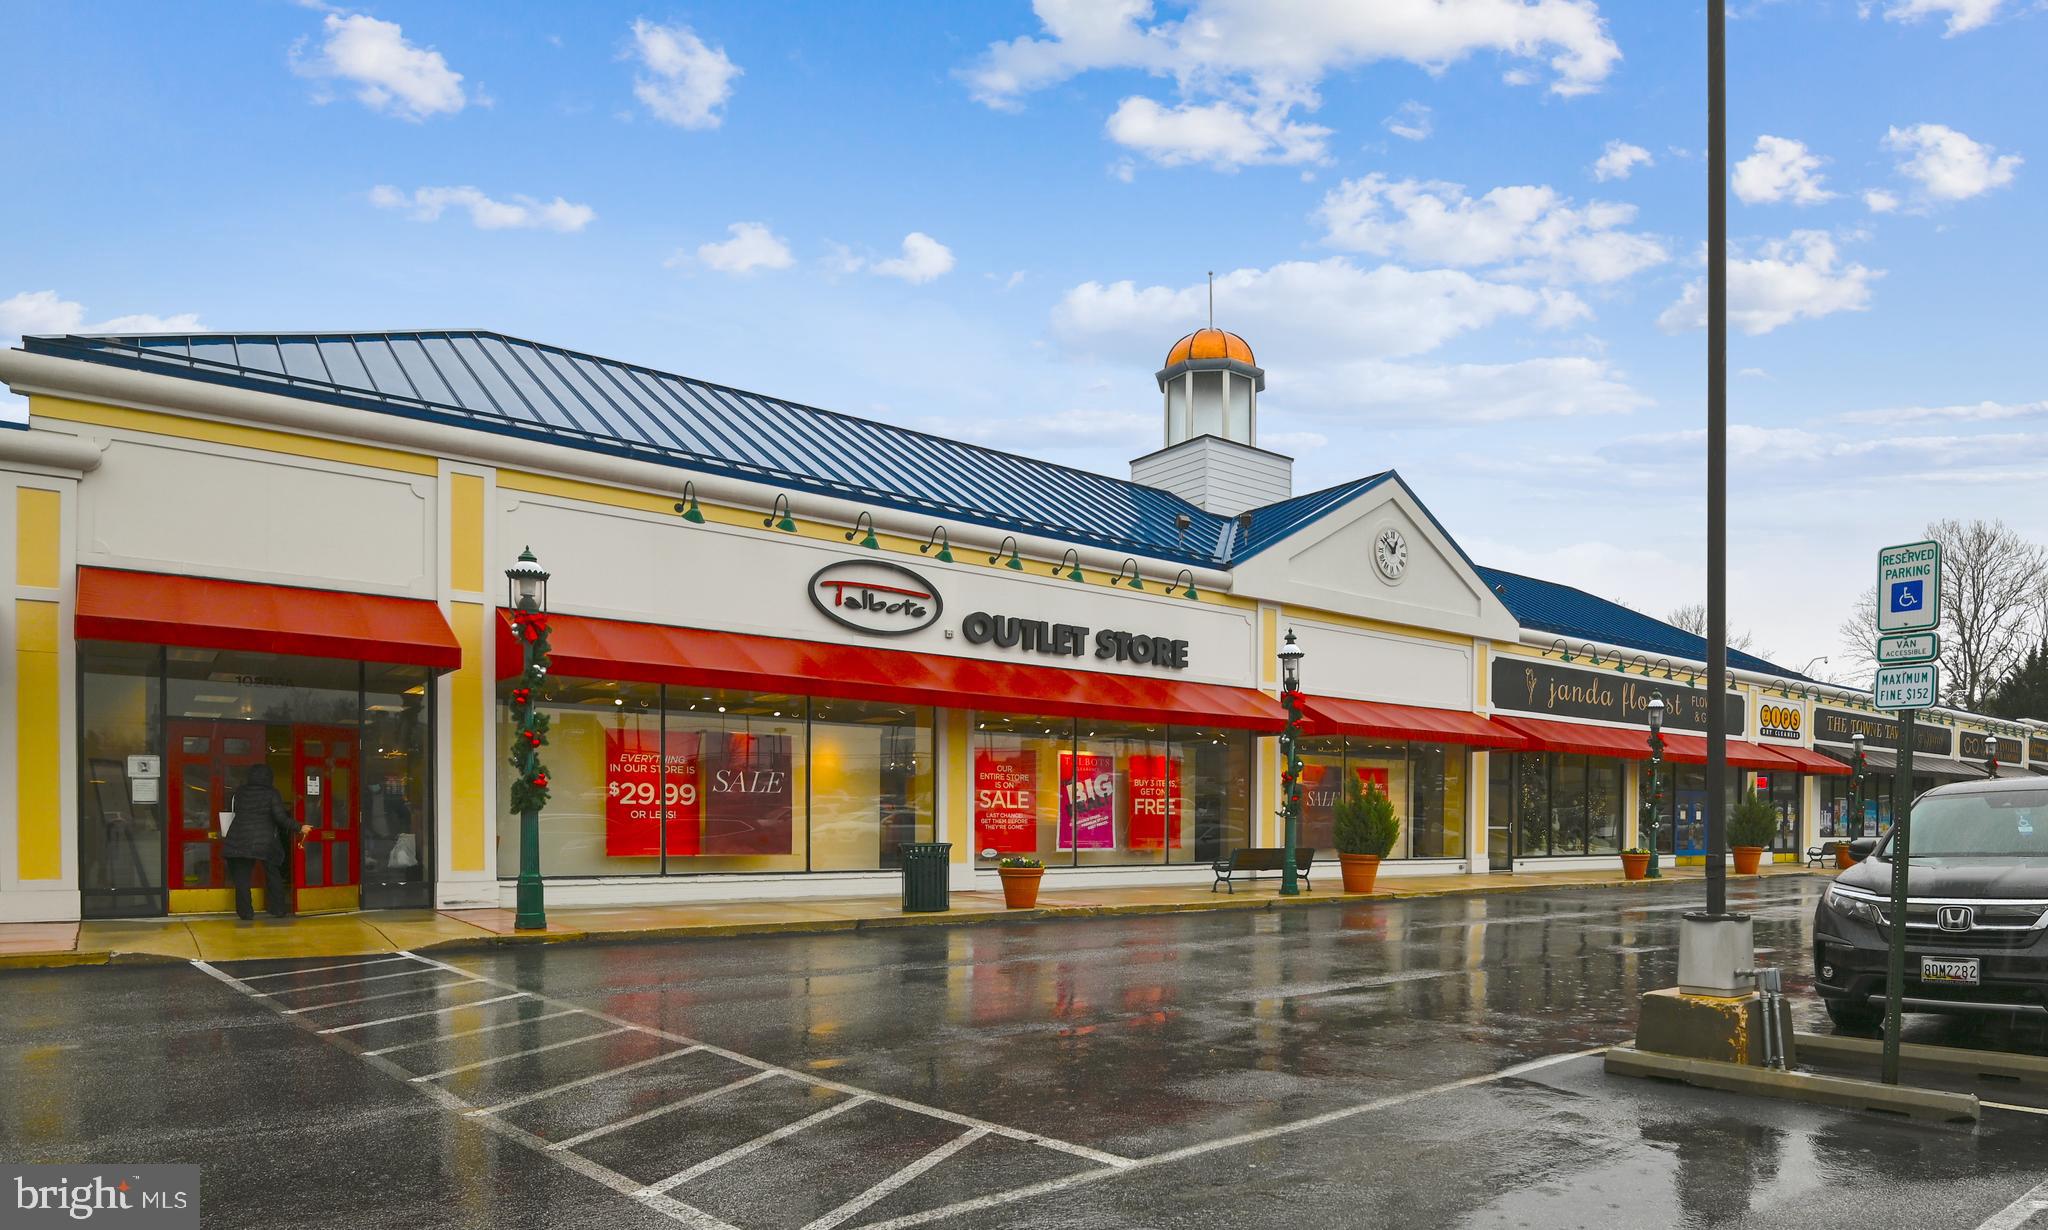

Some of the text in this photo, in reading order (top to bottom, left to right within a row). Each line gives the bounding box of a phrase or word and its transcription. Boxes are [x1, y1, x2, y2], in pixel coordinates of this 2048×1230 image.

[1882, 550, 1934, 567] RESERVED
[1886, 564, 1931, 580] PARKING
[820, 580, 932, 618] Talbots
[962, 612, 1189, 669] OUTLET STORE
[1896, 639, 1917, 649] VAN
[1886, 648, 1927, 657] ACCESSIBLE
[1882, 671, 1928, 685] MAXIMUM
[1547, 677, 1683, 717] janda flost
[1880, 688, 1929, 701] FINE $152
[1827, 715, 1847, 733] THE
[1851, 719, 1882, 738] TOWNE
[620, 753, 686, 764] EVERYTING
[1065, 757, 1110, 767] TLBOTS
[609, 763, 620, 772] IN
[623, 764, 648, 773] OUR
[686, 766, 695, 774] IS
[712, 769, 785, 793] SALE
[980, 772, 1029, 782] ENTIRE STORE
[1134, 779, 1149, 787] BUY
[994, 781, 1015, 789] IS ON
[1066, 773, 1113, 805] BIG
[1140, 788, 1155, 796] GET
[608, 781, 696, 806] $29.99
[980, 790, 1030, 808] SALE
[1134, 798, 1176, 815] FREE
[630, 810, 677, 819] OR LES!
